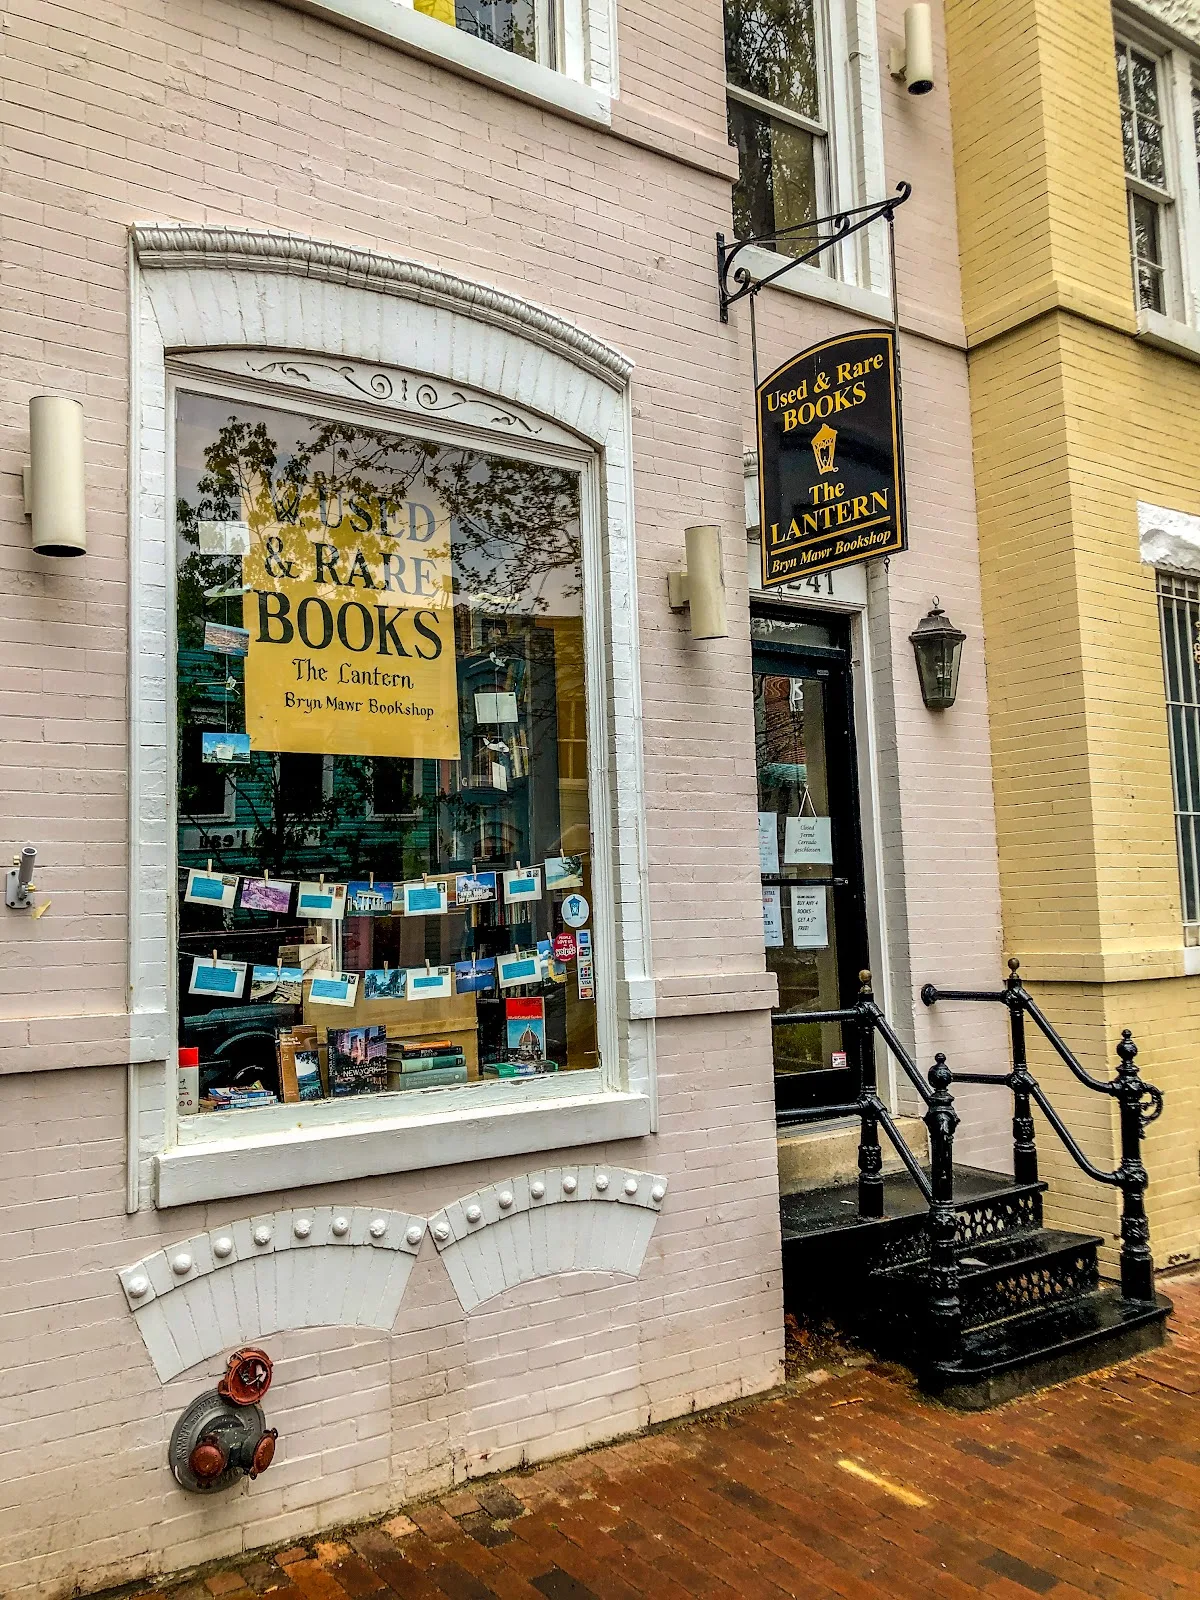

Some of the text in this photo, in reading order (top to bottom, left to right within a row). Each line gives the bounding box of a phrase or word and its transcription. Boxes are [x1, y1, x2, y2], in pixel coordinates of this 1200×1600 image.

[766, 353, 884, 412] Used & Rare
[782, 381, 867, 432] BOOKS
[319, 486, 436, 543] USED
[770, 488, 889, 546] LANTERN
[808, 482, 845, 505] The
[265, 536, 438, 598] & RARE
[771, 529, 891, 574] Bryn Mawr Bookshop
[786, 571, 834, 595] 41
[253, 589, 442, 660] BOOKS
[291, 658, 414, 690] The Lantern
[284, 692, 434, 721] Bryn Mawr Bookshop
